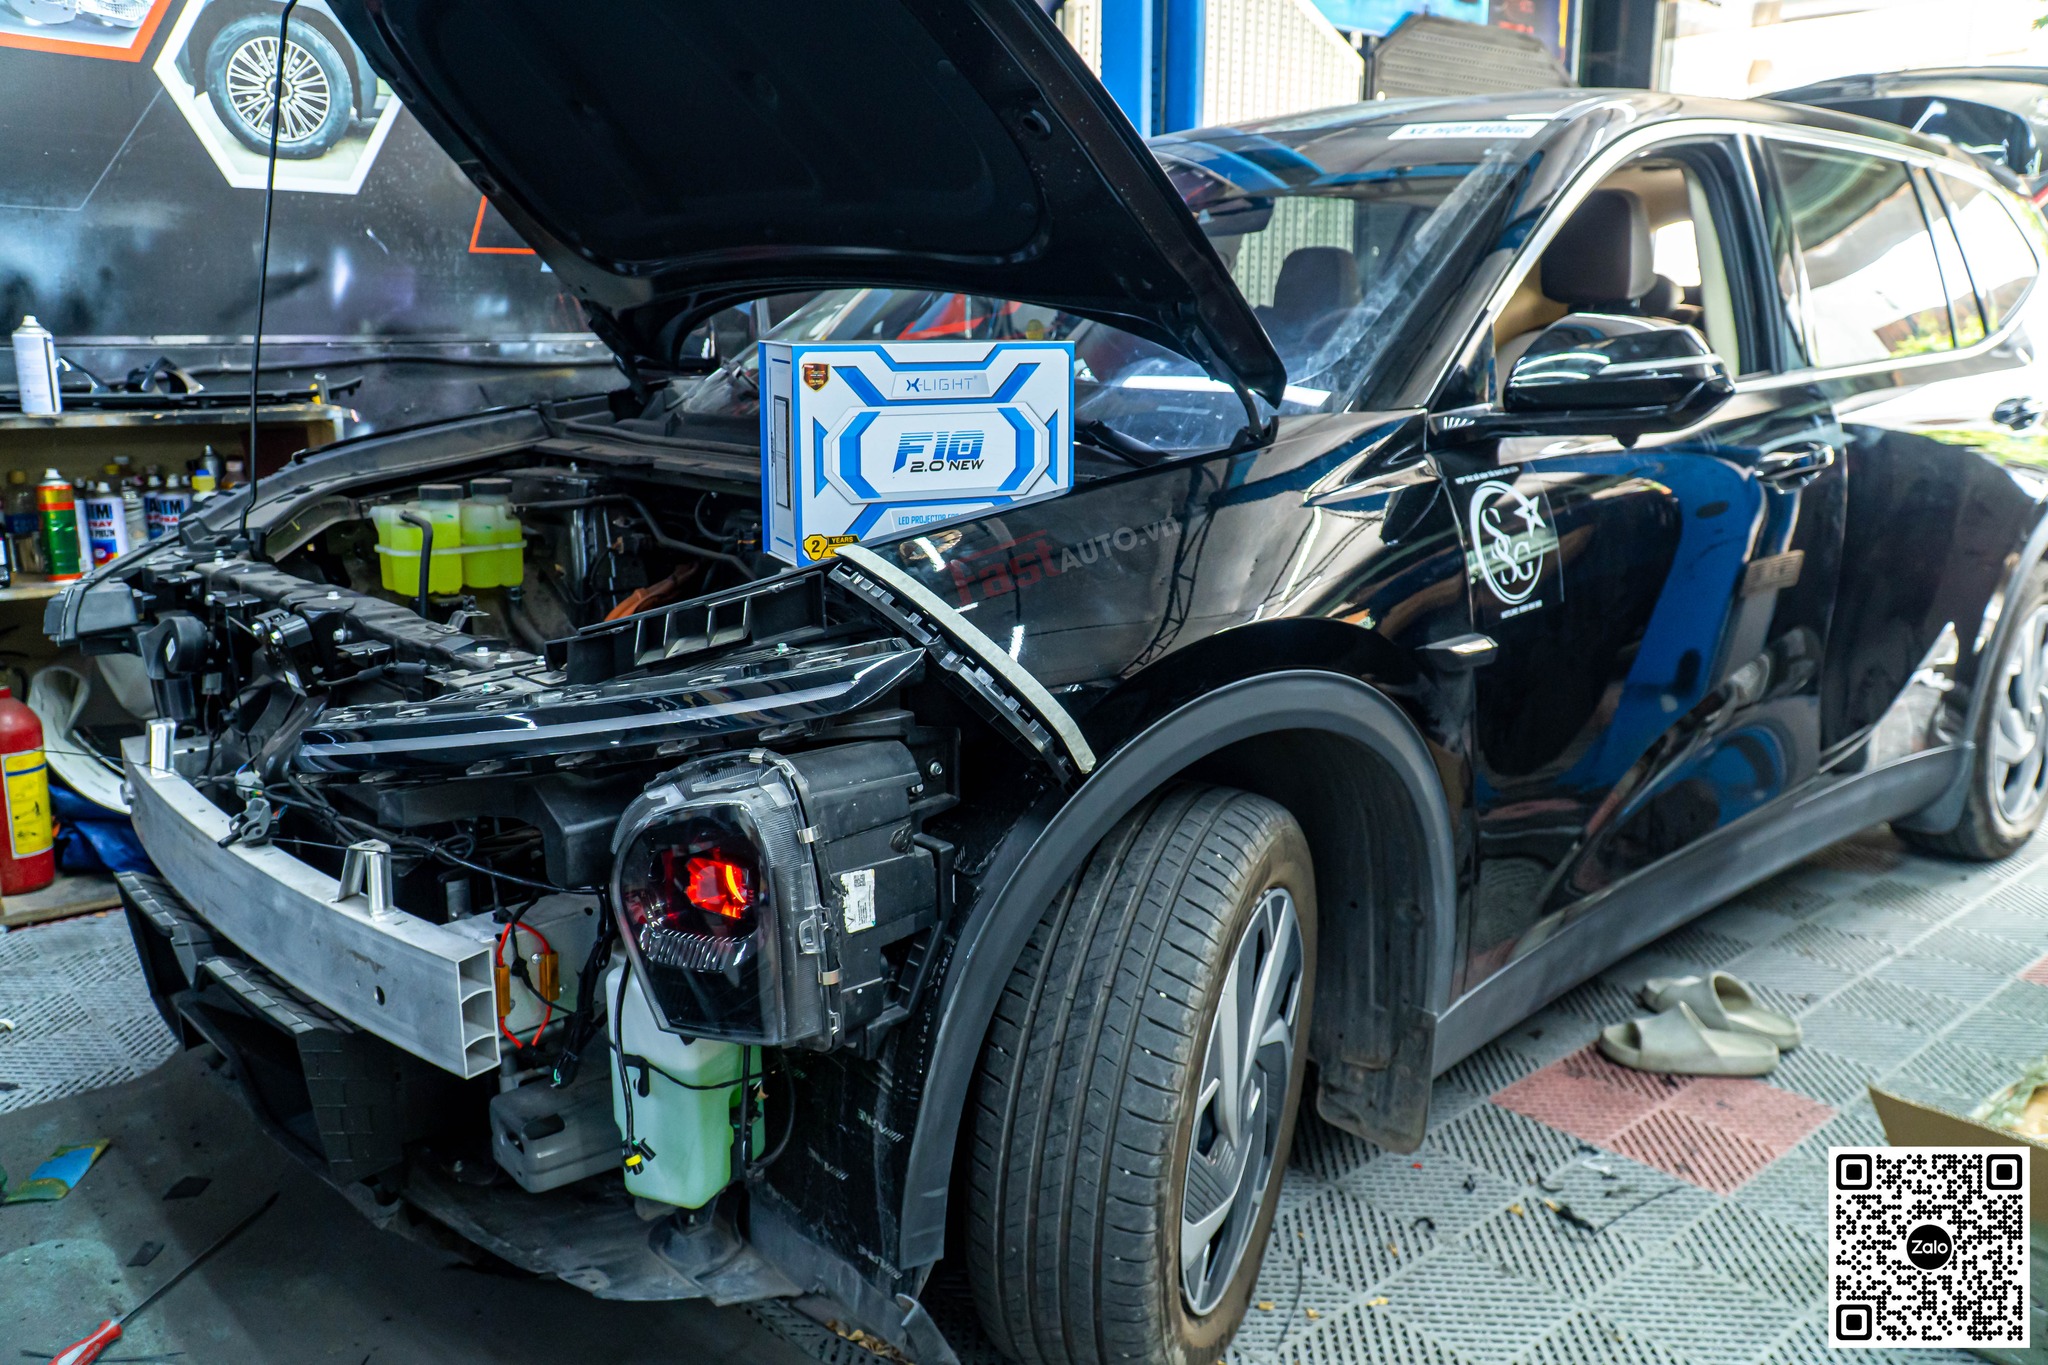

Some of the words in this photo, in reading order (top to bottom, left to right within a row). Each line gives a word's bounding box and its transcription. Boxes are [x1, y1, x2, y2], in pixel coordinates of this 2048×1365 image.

[910, 460, 945, 473] 2.0
[948, 459, 985, 471] NEW
[898, 516, 910, 525] LED
[831, 536, 854, 544] YEARS
[811, 539, 821, 553] 2
